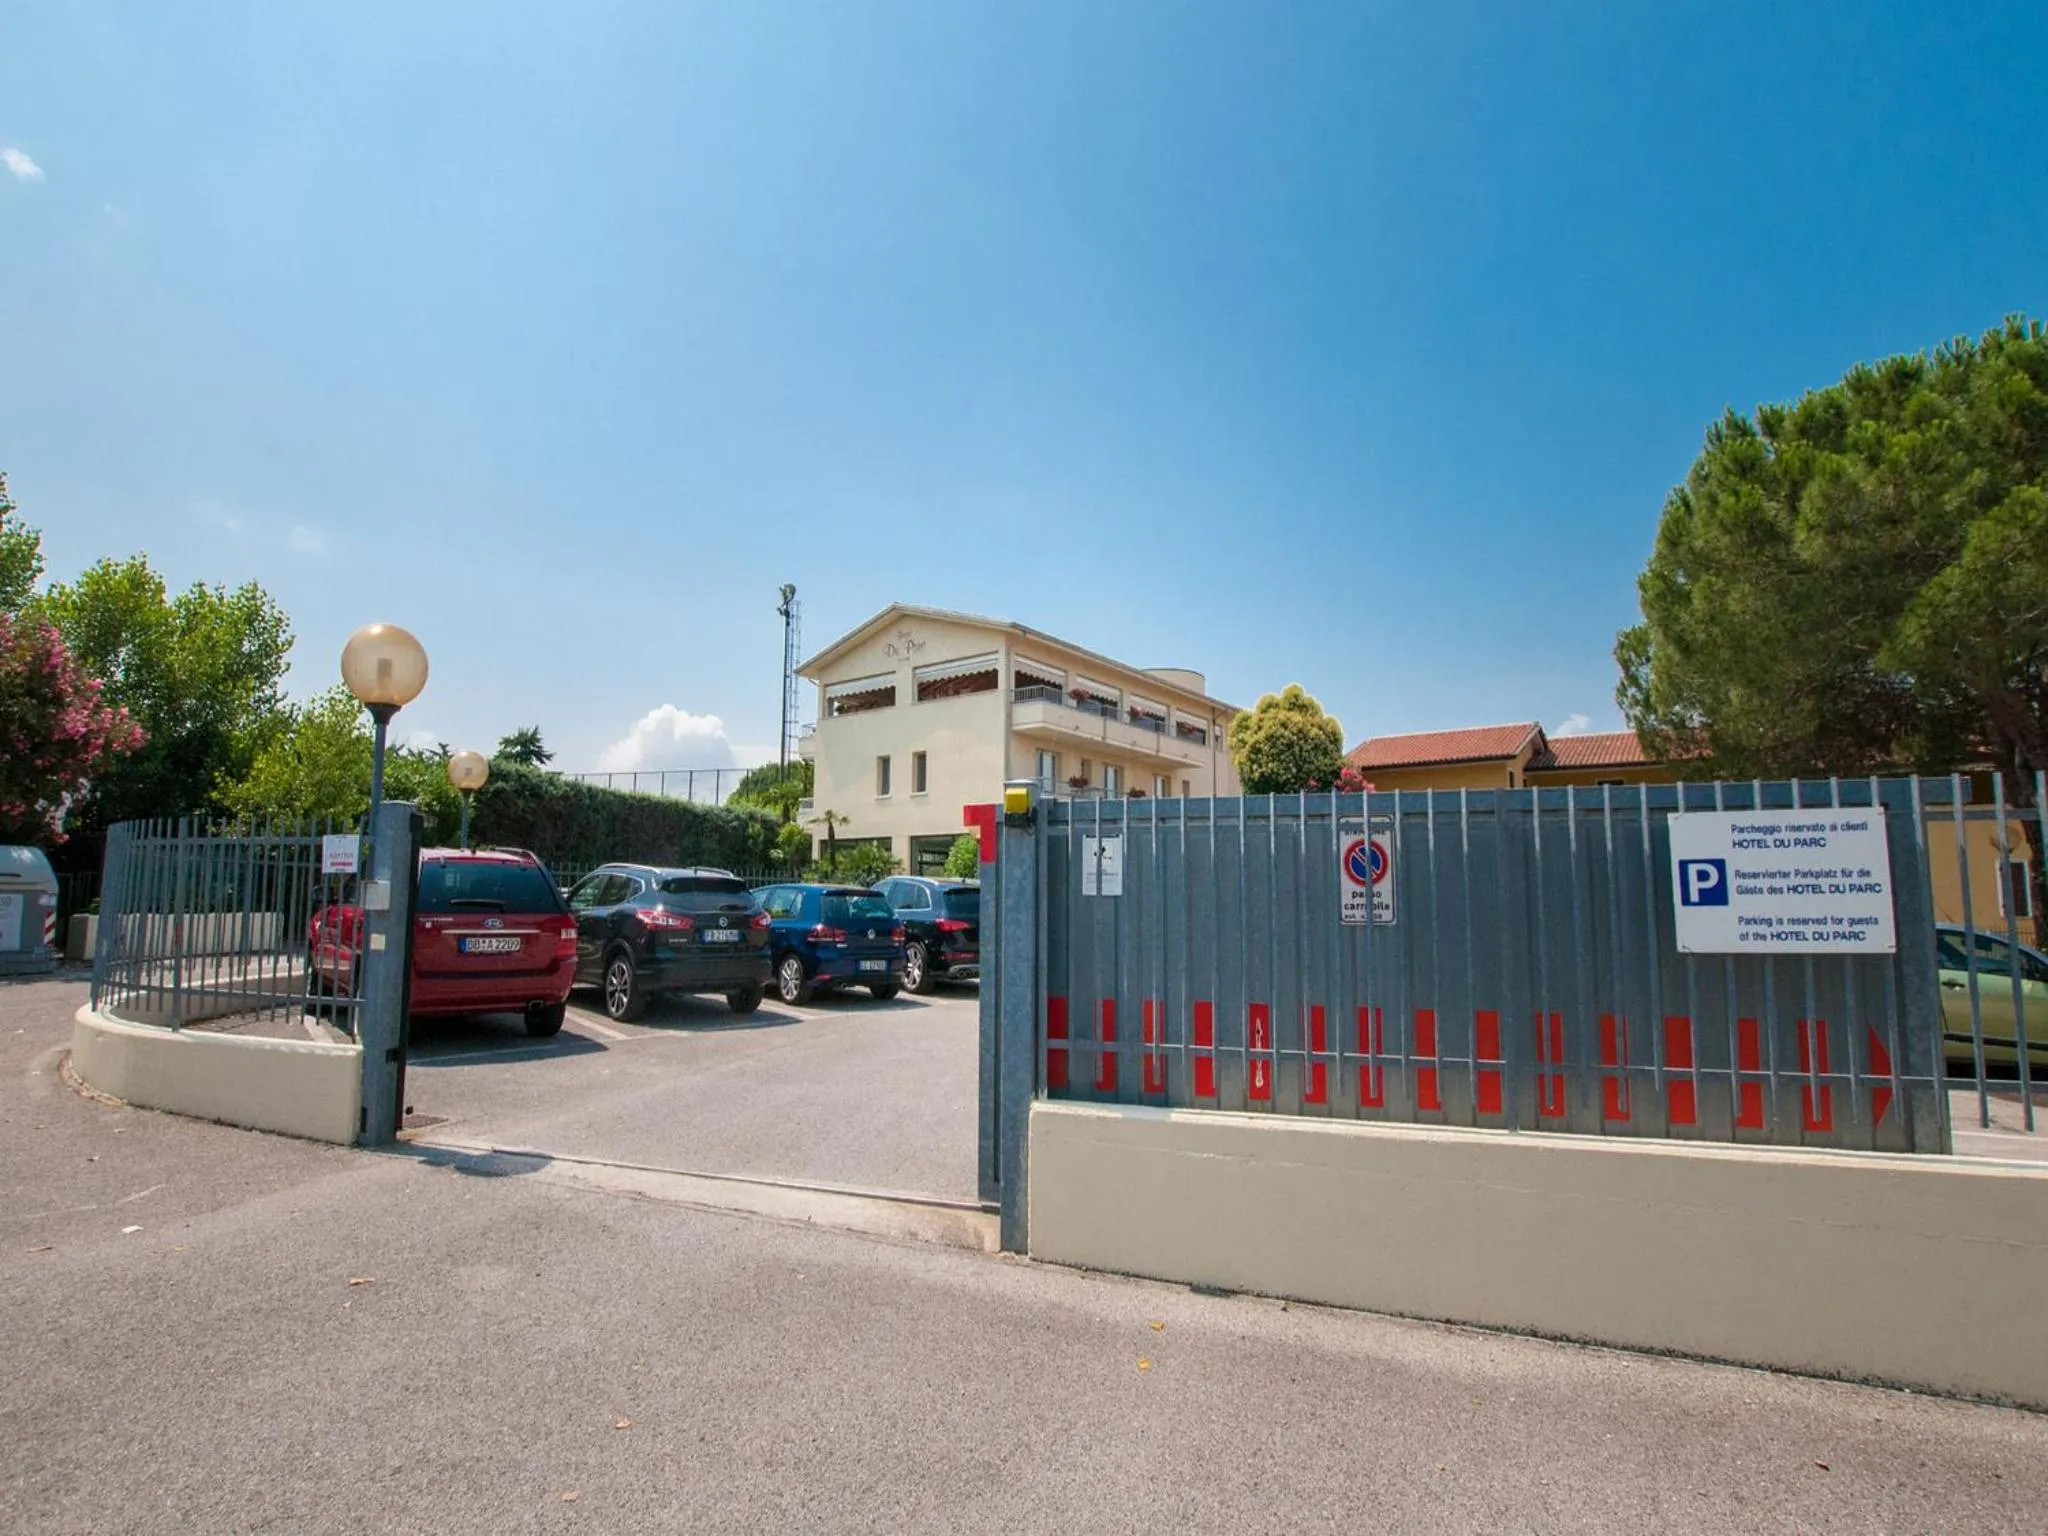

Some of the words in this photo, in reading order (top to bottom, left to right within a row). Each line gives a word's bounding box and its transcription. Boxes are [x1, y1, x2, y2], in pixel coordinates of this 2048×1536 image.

[1730, 823, 1782, 835] Parcheggio
[1785, 822, 1826, 833] riservato
[1829, 823, 1838, 832] ai
[1840, 820, 1868, 832] clienti
[1732, 839, 1770, 849] HOTEL
[1773, 838, 1791, 848] DU
[1793, 837, 1826, 848] PARC
[1734, 869, 1791, 880] Reservierter
[1794, 868, 1838, 880] Parkplatz
[1841, 867, 1853, 878] für
[1857, 867, 1871, 878] die
[1687, 863, 1719, 903] P
[1736, 884, 1764, 895] Gäste
[1766, 885, 1784, 895] des
[1786, 883, 1826, 894] HOTEL
[1828, 883, 1846, 894] DU
[1849, 882, 1883, 893] PARC
[1738, 915, 1773, 927] Parking
[1775, 915, 1784, 926] is
[1787, 914, 1828, 926] reserved
[1830, 914, 1843, 926] for
[1847, 914, 1879, 927] guests
[1739, 931, 1749, 942] of
[1752, 931, 1767, 942] the
[1770, 930, 1809, 942] HOTEL
[1812, 930, 1830, 941] DU
[1833, 929, 1866, 941] PARC
